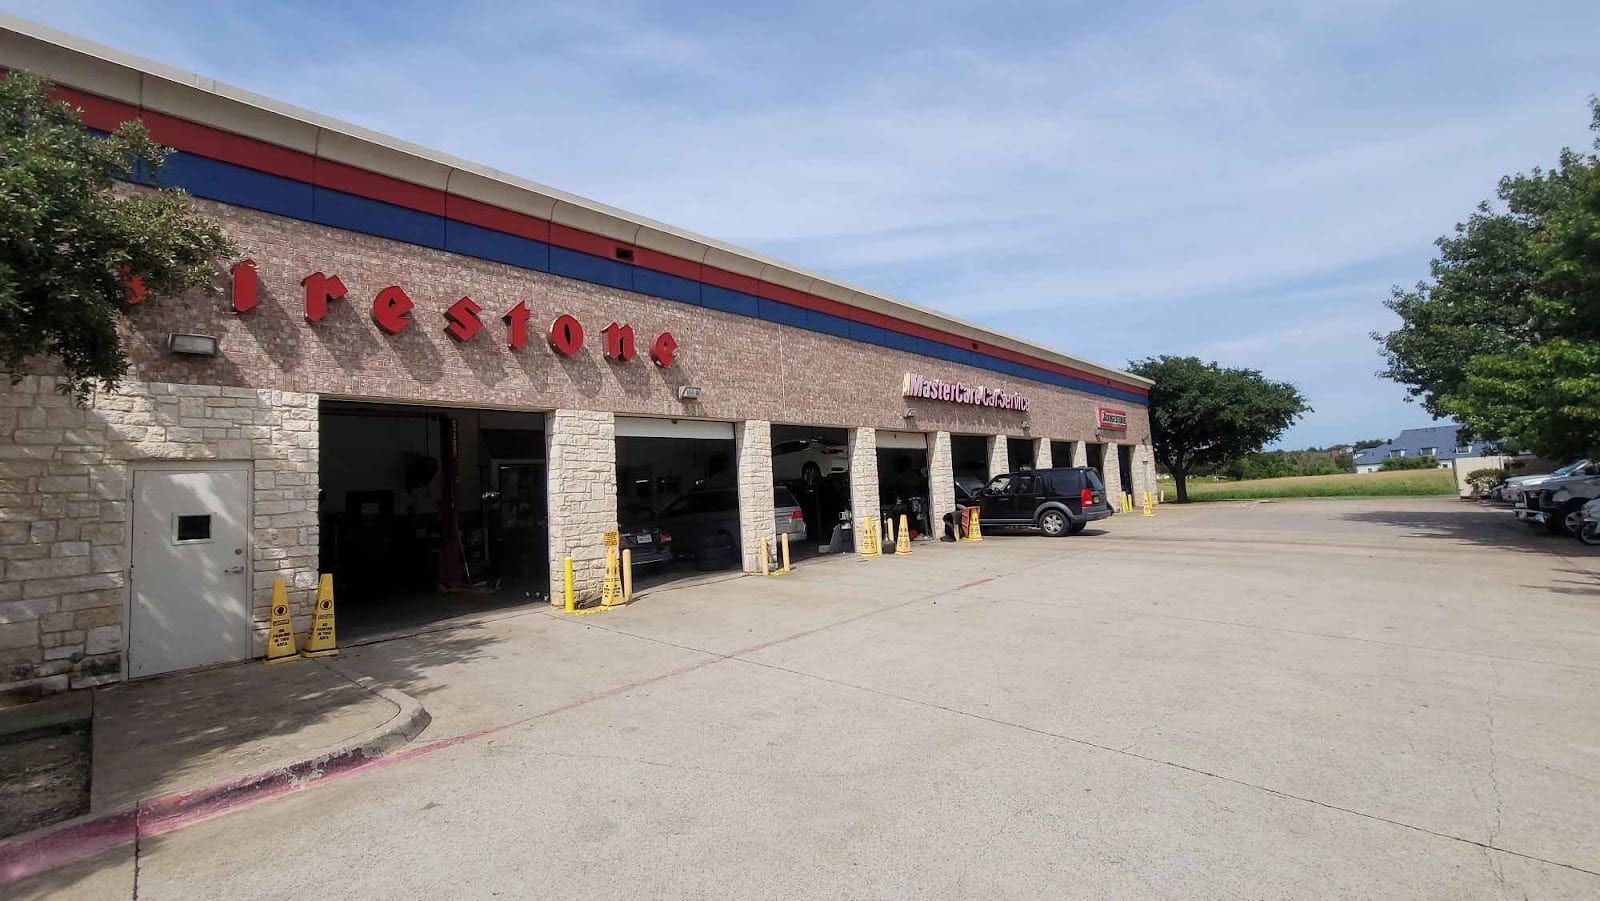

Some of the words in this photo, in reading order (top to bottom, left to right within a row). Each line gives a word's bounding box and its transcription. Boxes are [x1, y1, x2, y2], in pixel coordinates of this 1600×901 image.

[117, 258, 678, 368] irestone
[910, 372, 980, 405] MasterCare
[983, 386, 1001, 408] Car
[1000, 390, 1031, 412] Service
